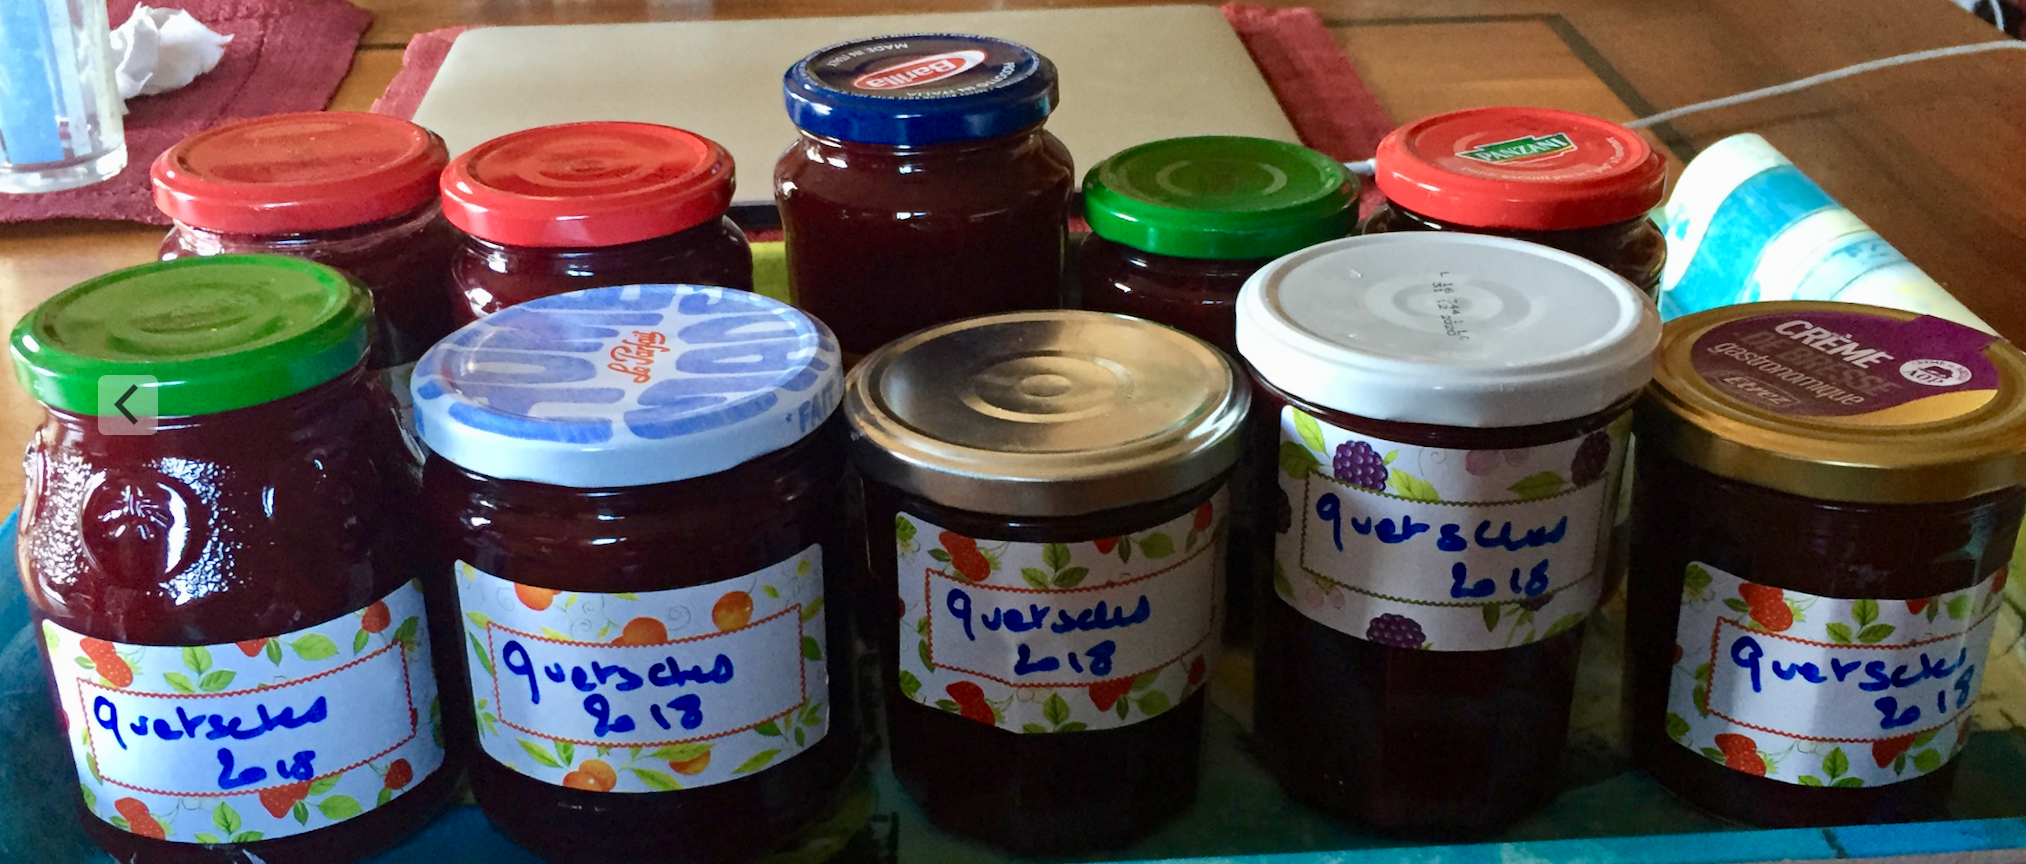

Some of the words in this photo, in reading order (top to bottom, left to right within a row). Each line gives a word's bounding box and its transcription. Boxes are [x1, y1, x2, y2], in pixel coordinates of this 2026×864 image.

[849, 50, 862, 61] IN
[862, 43, 908, 55] MADE
[866, 59, 957, 89] Barilla
[1476, 136, 1567, 162] PANZANI
[1440, 314, 1457, 337] 2020
[610, 330, 671, 366] Parfait
[1774, 320, 1895, 370] CRÈME
[607, 362, 651, 384] Le
[1707, 341, 1865, 406] gastronomique
[1779, 346, 1903, 397] BRESSE
[1450, 558, 1550, 600] 2018
[1013, 639, 1117, 677] 2018
[583, 693, 704, 738] 2018
[1873, 664, 1976, 731] 2018
[217, 747, 316, 790] 2018
